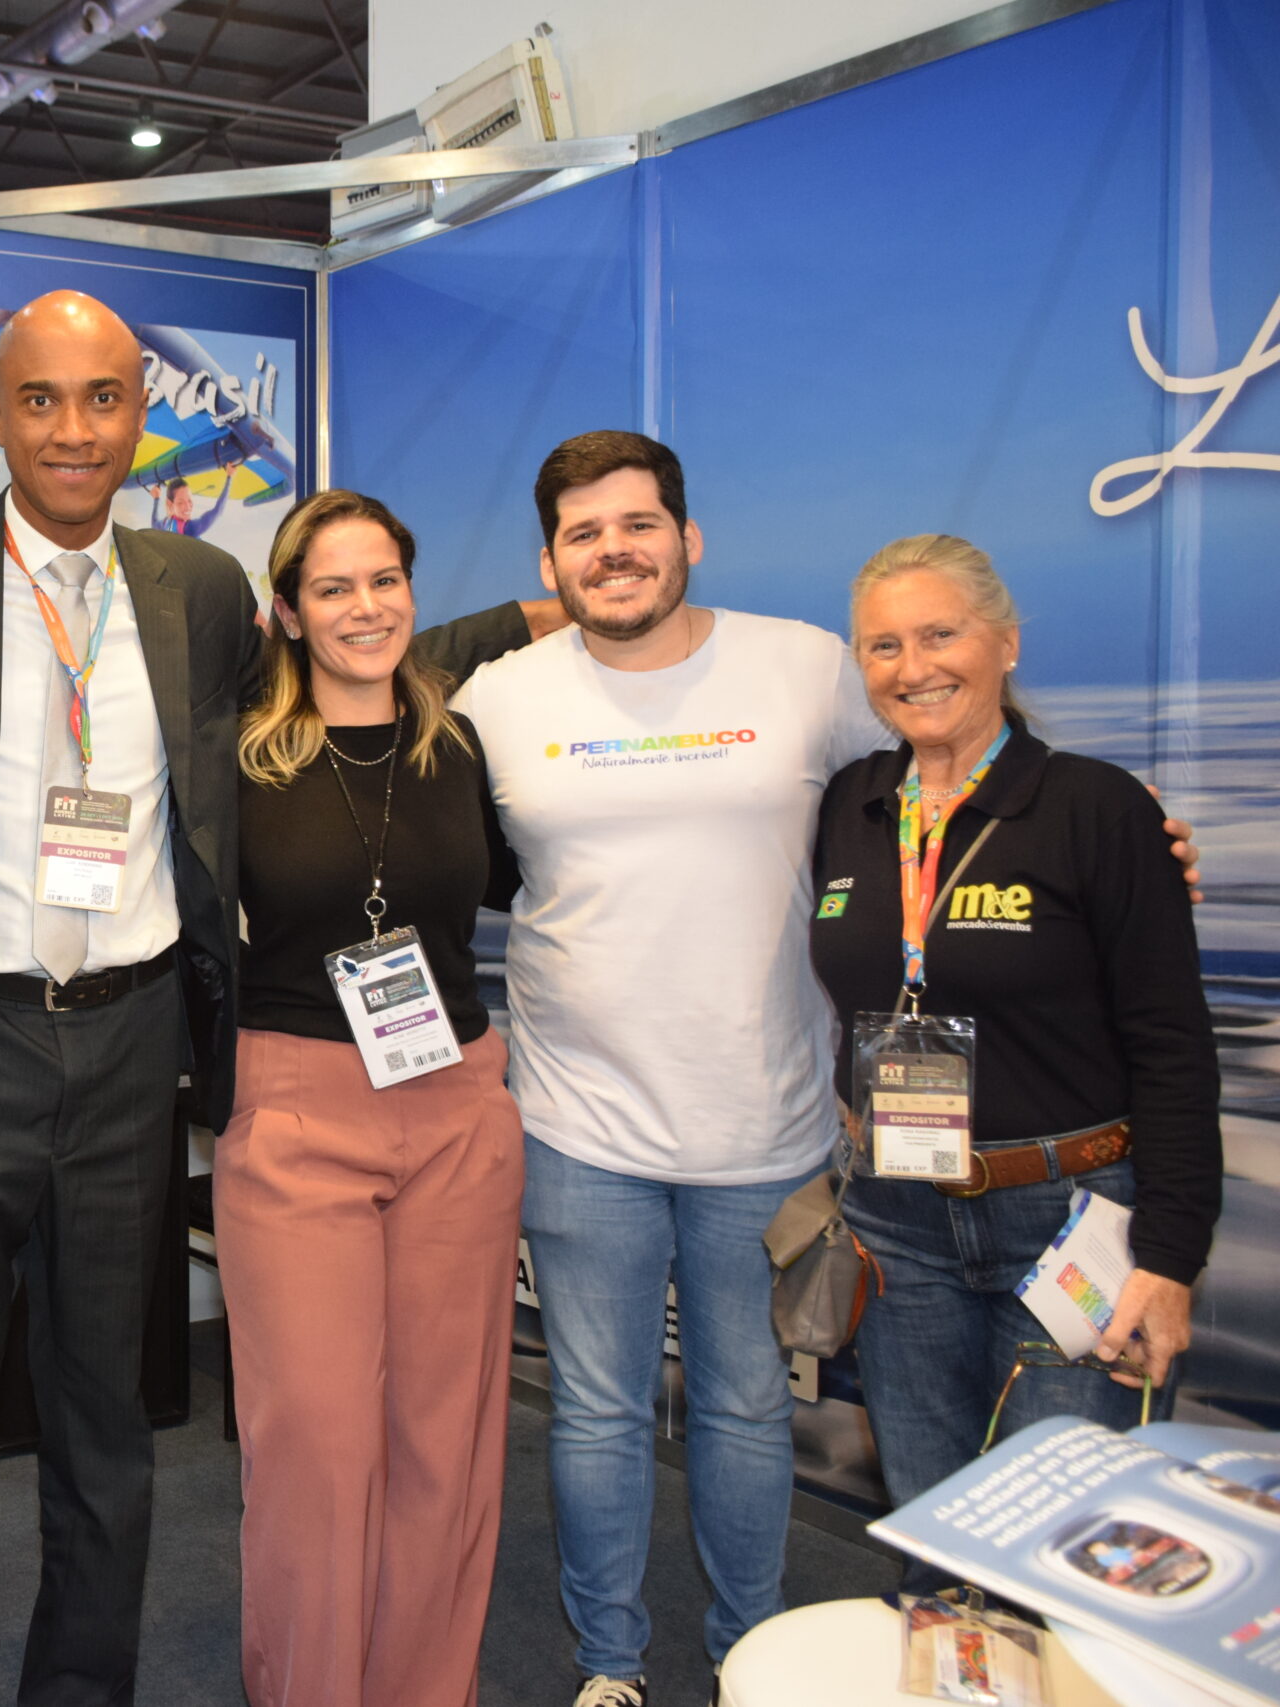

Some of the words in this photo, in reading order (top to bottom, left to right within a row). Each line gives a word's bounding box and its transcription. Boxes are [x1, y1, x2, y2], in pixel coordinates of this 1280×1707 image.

[569, 728, 757, 756] PERNAMBUCO
[581, 753, 671, 770] Naturalmente
[56, 847, 112, 860] EXPOSITOR
[947, 882, 1033, 921] m&e
[946, 919, 1033, 933] mercado&eventos
[384, 1014, 427, 1033] EXPOSITOR
[888, 1114, 950, 1126] EXPOSITOR
